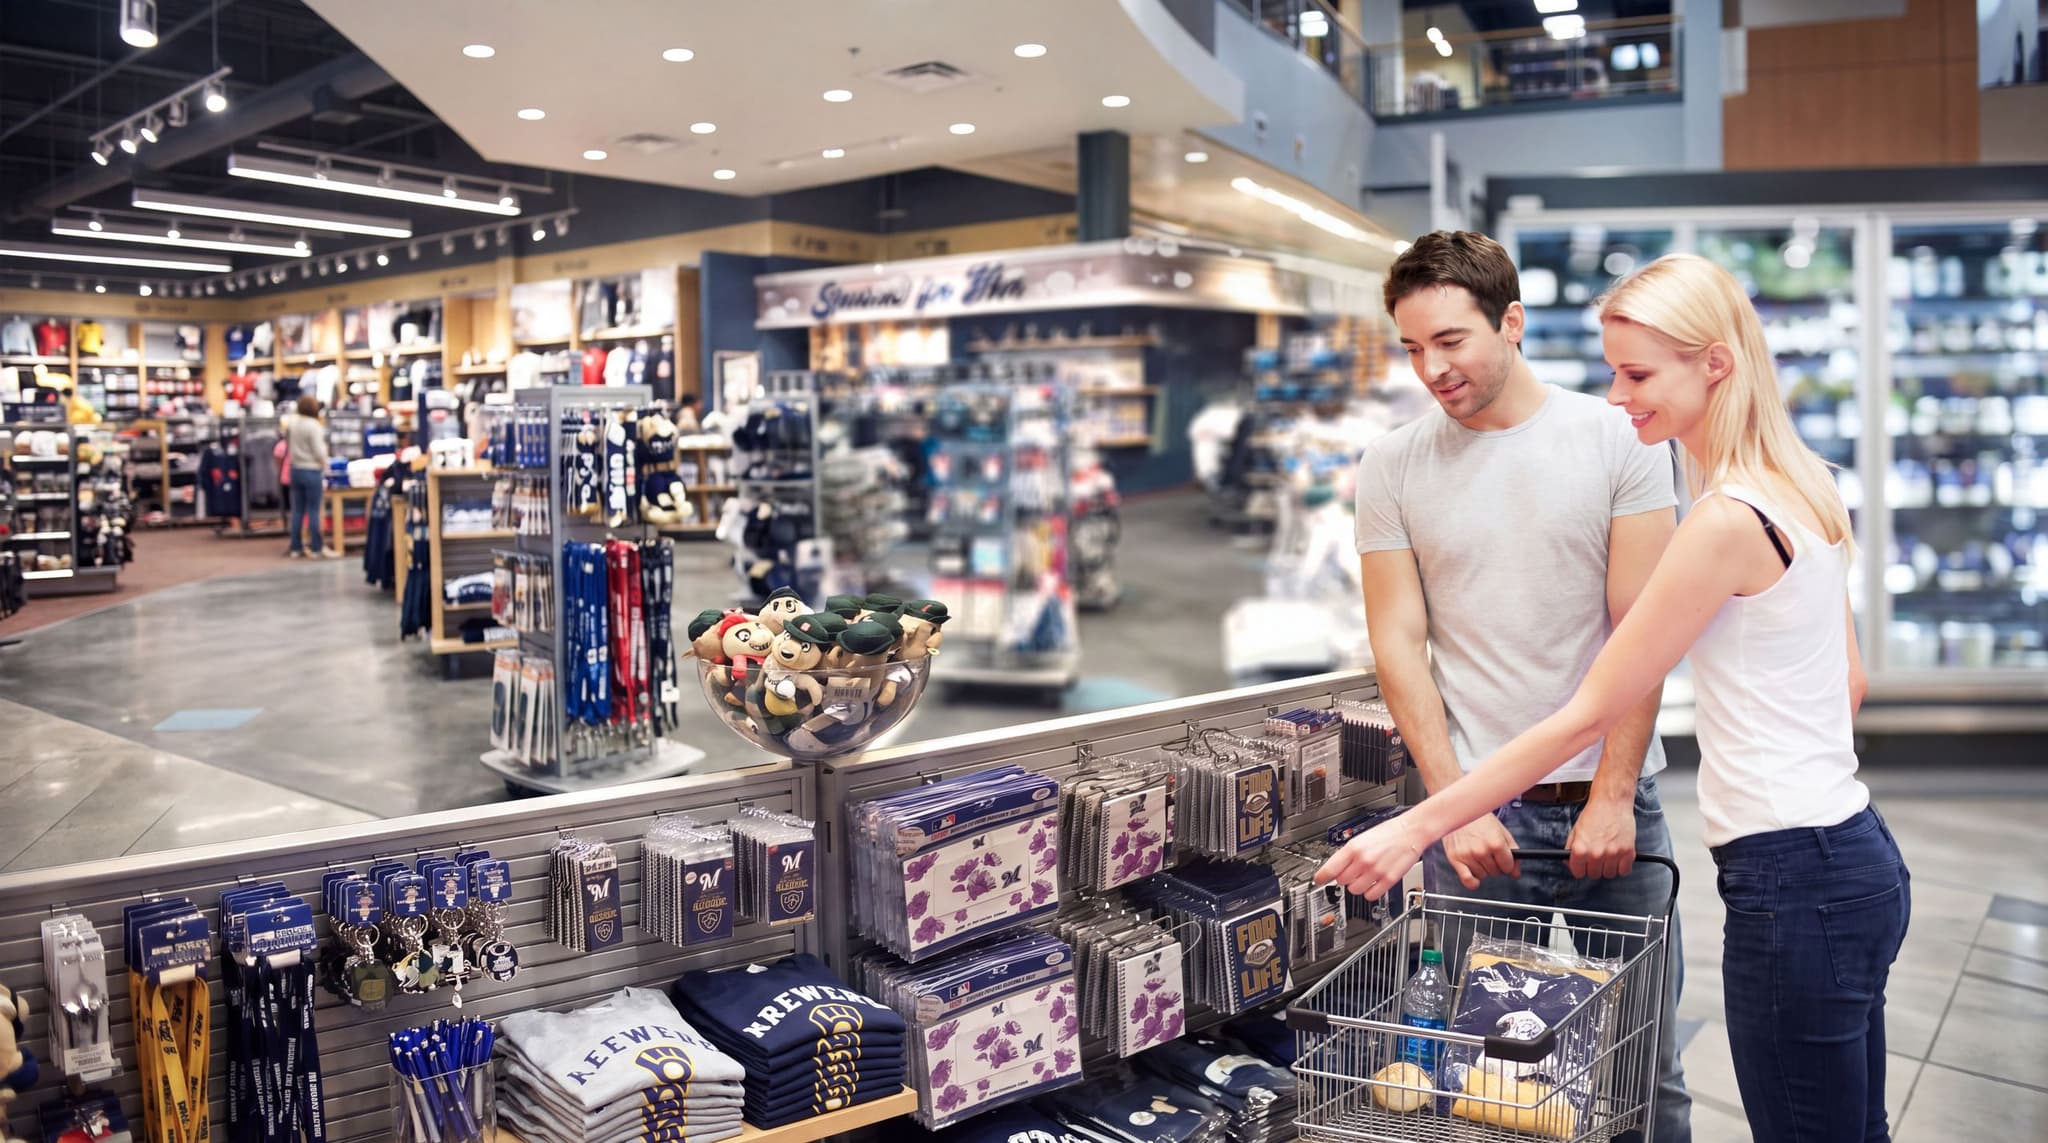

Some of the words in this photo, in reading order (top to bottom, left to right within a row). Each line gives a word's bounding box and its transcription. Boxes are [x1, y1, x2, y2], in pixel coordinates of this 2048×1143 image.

[1239, 768, 1273, 801] FOR
[1239, 808, 1273, 843] LIFE
[1235, 913, 1278, 954] FOR
[1240, 956, 1284, 999] LIFE
